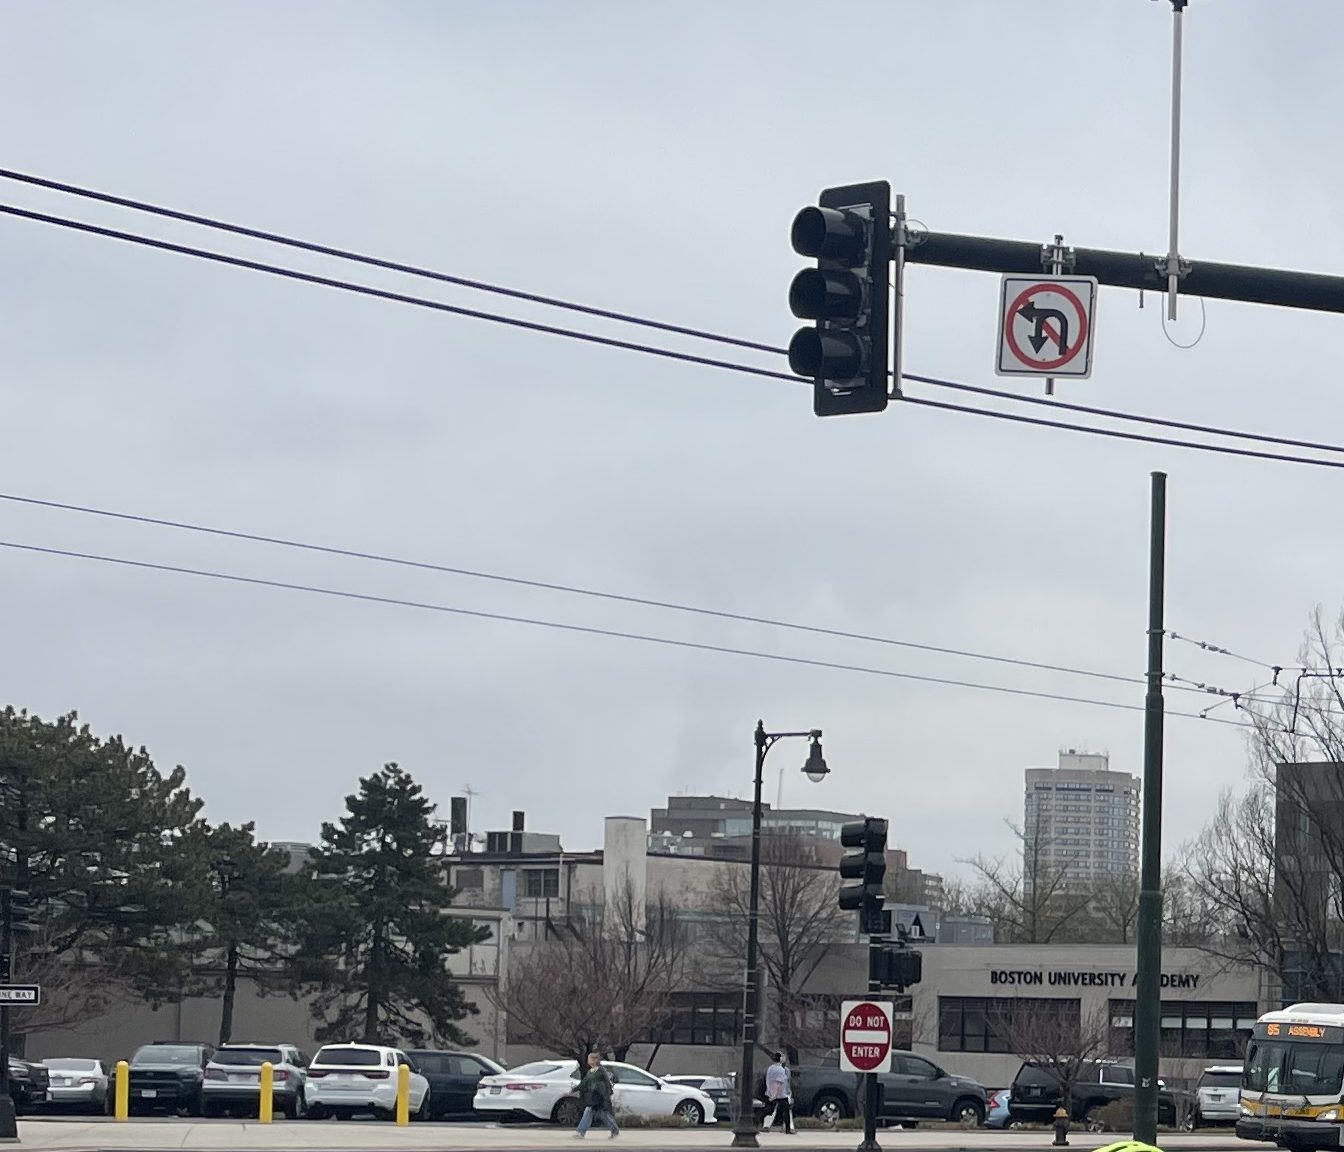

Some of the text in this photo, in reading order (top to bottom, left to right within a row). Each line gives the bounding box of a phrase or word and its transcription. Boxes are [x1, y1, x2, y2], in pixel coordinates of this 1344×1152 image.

[990, 970, 1043, 986] BOSTON
[1048, 970, 1127, 987] UNIVERSITY
[15, 991, 32, 999] WAY
[849, 1015, 885, 1028] DO NOT
[1267, 1023, 1326, 1038] 85 ASSEMBLY
[851, 1045, 880, 1058] ENTER
